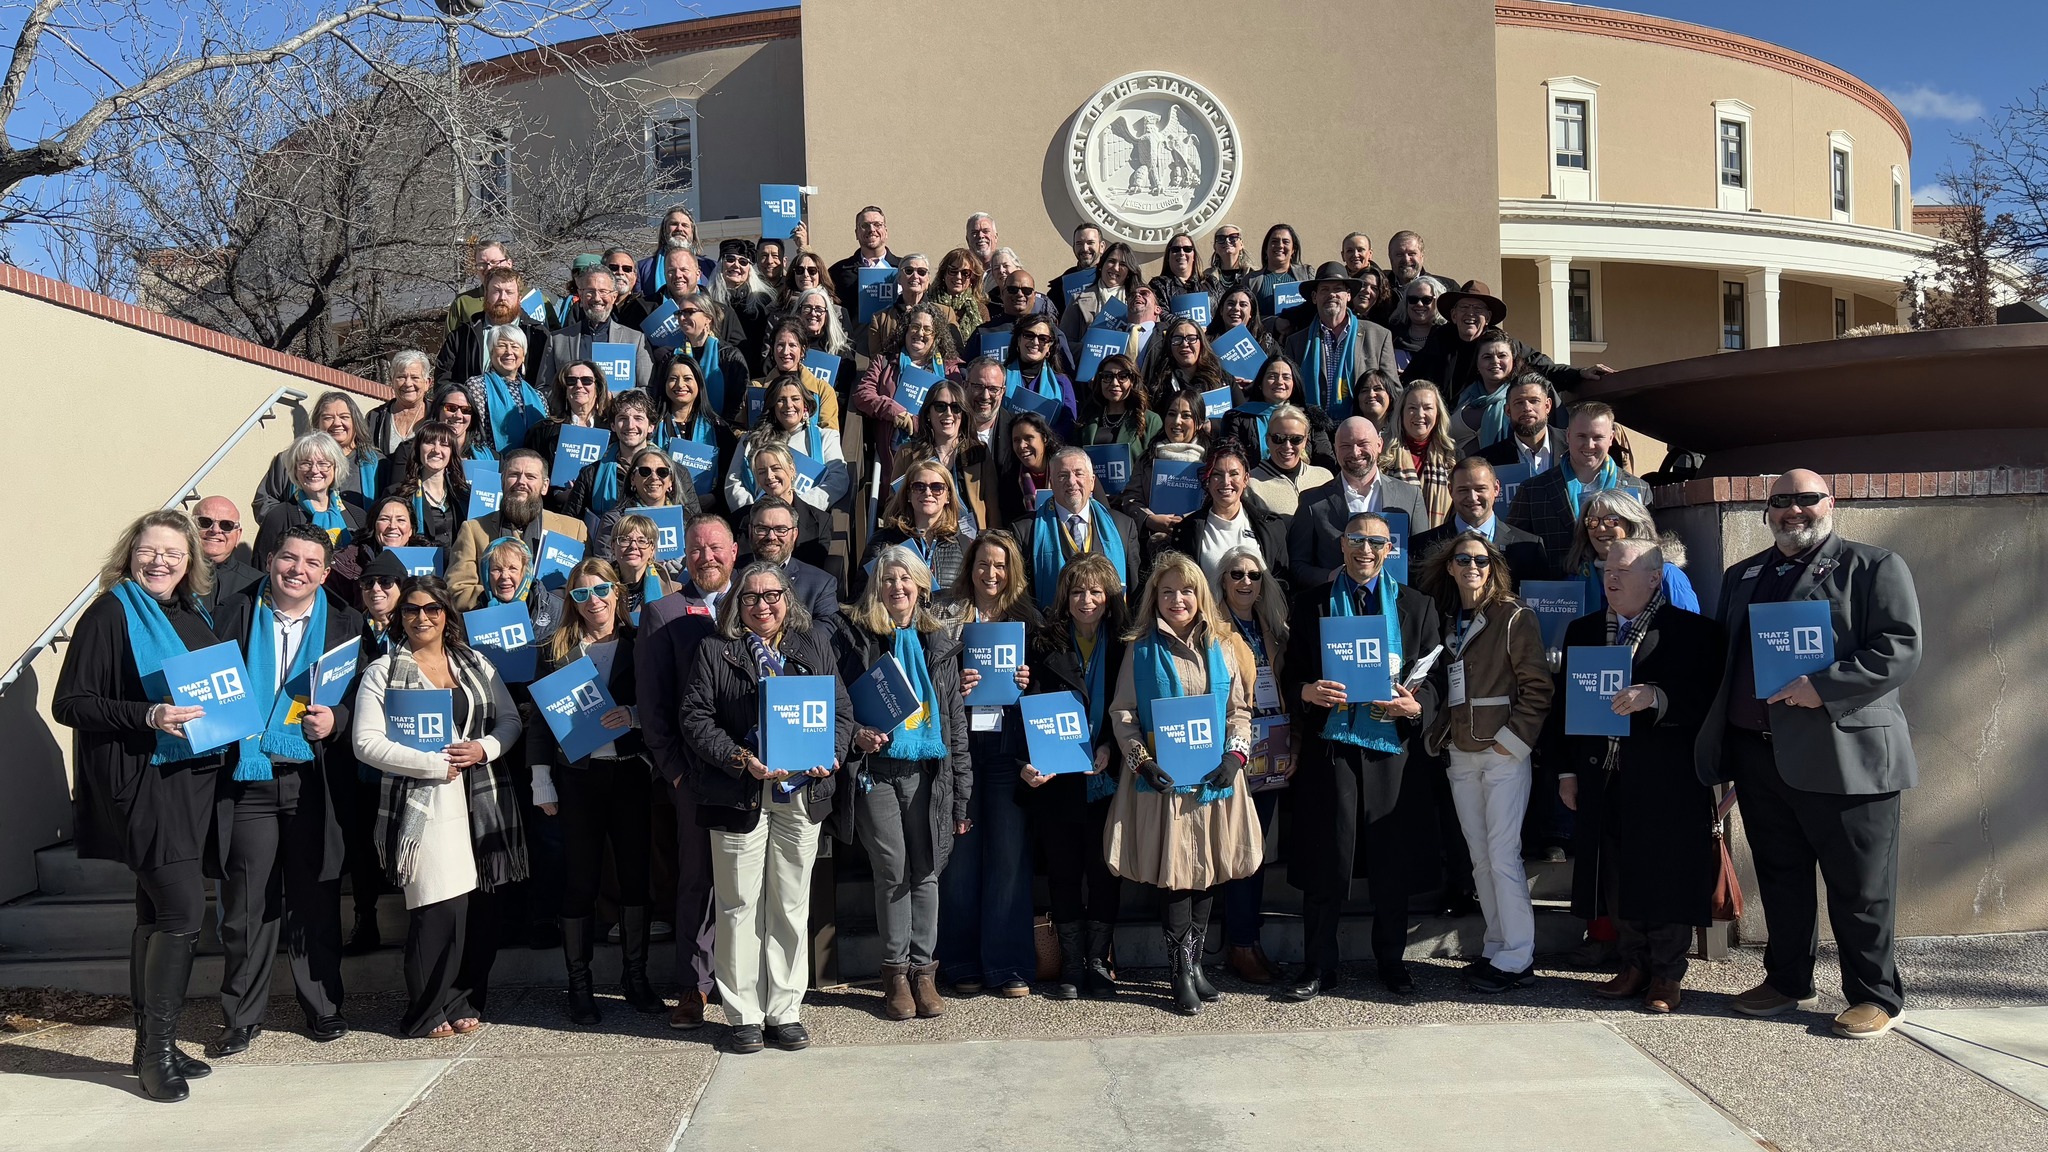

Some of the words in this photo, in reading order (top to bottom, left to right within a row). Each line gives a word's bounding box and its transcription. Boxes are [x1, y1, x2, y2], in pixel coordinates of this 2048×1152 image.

[1107, 79, 1140, 102] THE
[1148, 77, 1202, 107] STATE
[1089, 99, 1105, 121] OF
[1202, 99, 1223, 123] OF
[1216, 123, 1235, 162] NEW
[1073, 129, 1091, 174] SEAL
[1080, 180, 1118, 227] GREAT
[1192, 171, 1234, 227] MEXICO
[1139, 227, 1175, 242] 1912
[1220, 348, 1237, 361] THAT'S
[562, 442, 581, 450] THAT'S
[1167, 482, 1198, 490] REALTORS
[475, 489, 496, 498] THAT'S
[1540, 597, 1554, 605] New
[1554, 597, 1579, 606] Mexico
[1539, 606, 1578, 614] REALTORS
[474, 631, 500, 642] THAT'S
[1757, 631, 1790, 640] THAT'S
[482, 637, 501, 646] WHO
[177, 678, 210, 694] THAT'S
[188, 684, 212, 699] WHO
[198, 693, 214, 703] WE
[876, 683, 900, 719] REALTORS
[889, 690, 903, 715] Mexico
[546, 695, 573, 713] THAT'S
[556, 701, 576, 714] WHO
[773, 704, 800, 712] THAT'S
[565, 705, 579, 717] WE
[780, 711, 800, 719] WHO
[389, 715, 415, 723] THAT'S
[1028, 717, 1054, 726] THAT'S
[396, 722, 415, 730] WHO
[1036, 723, 1055, 732] WHO
[1159, 724, 1186, 733] THAT'S
[403, 728, 415, 736] WE
[1044, 728, 1056, 736] WE
[1167, 730, 1186, 739] WHO
[1173, 736, 1187, 744] WE
